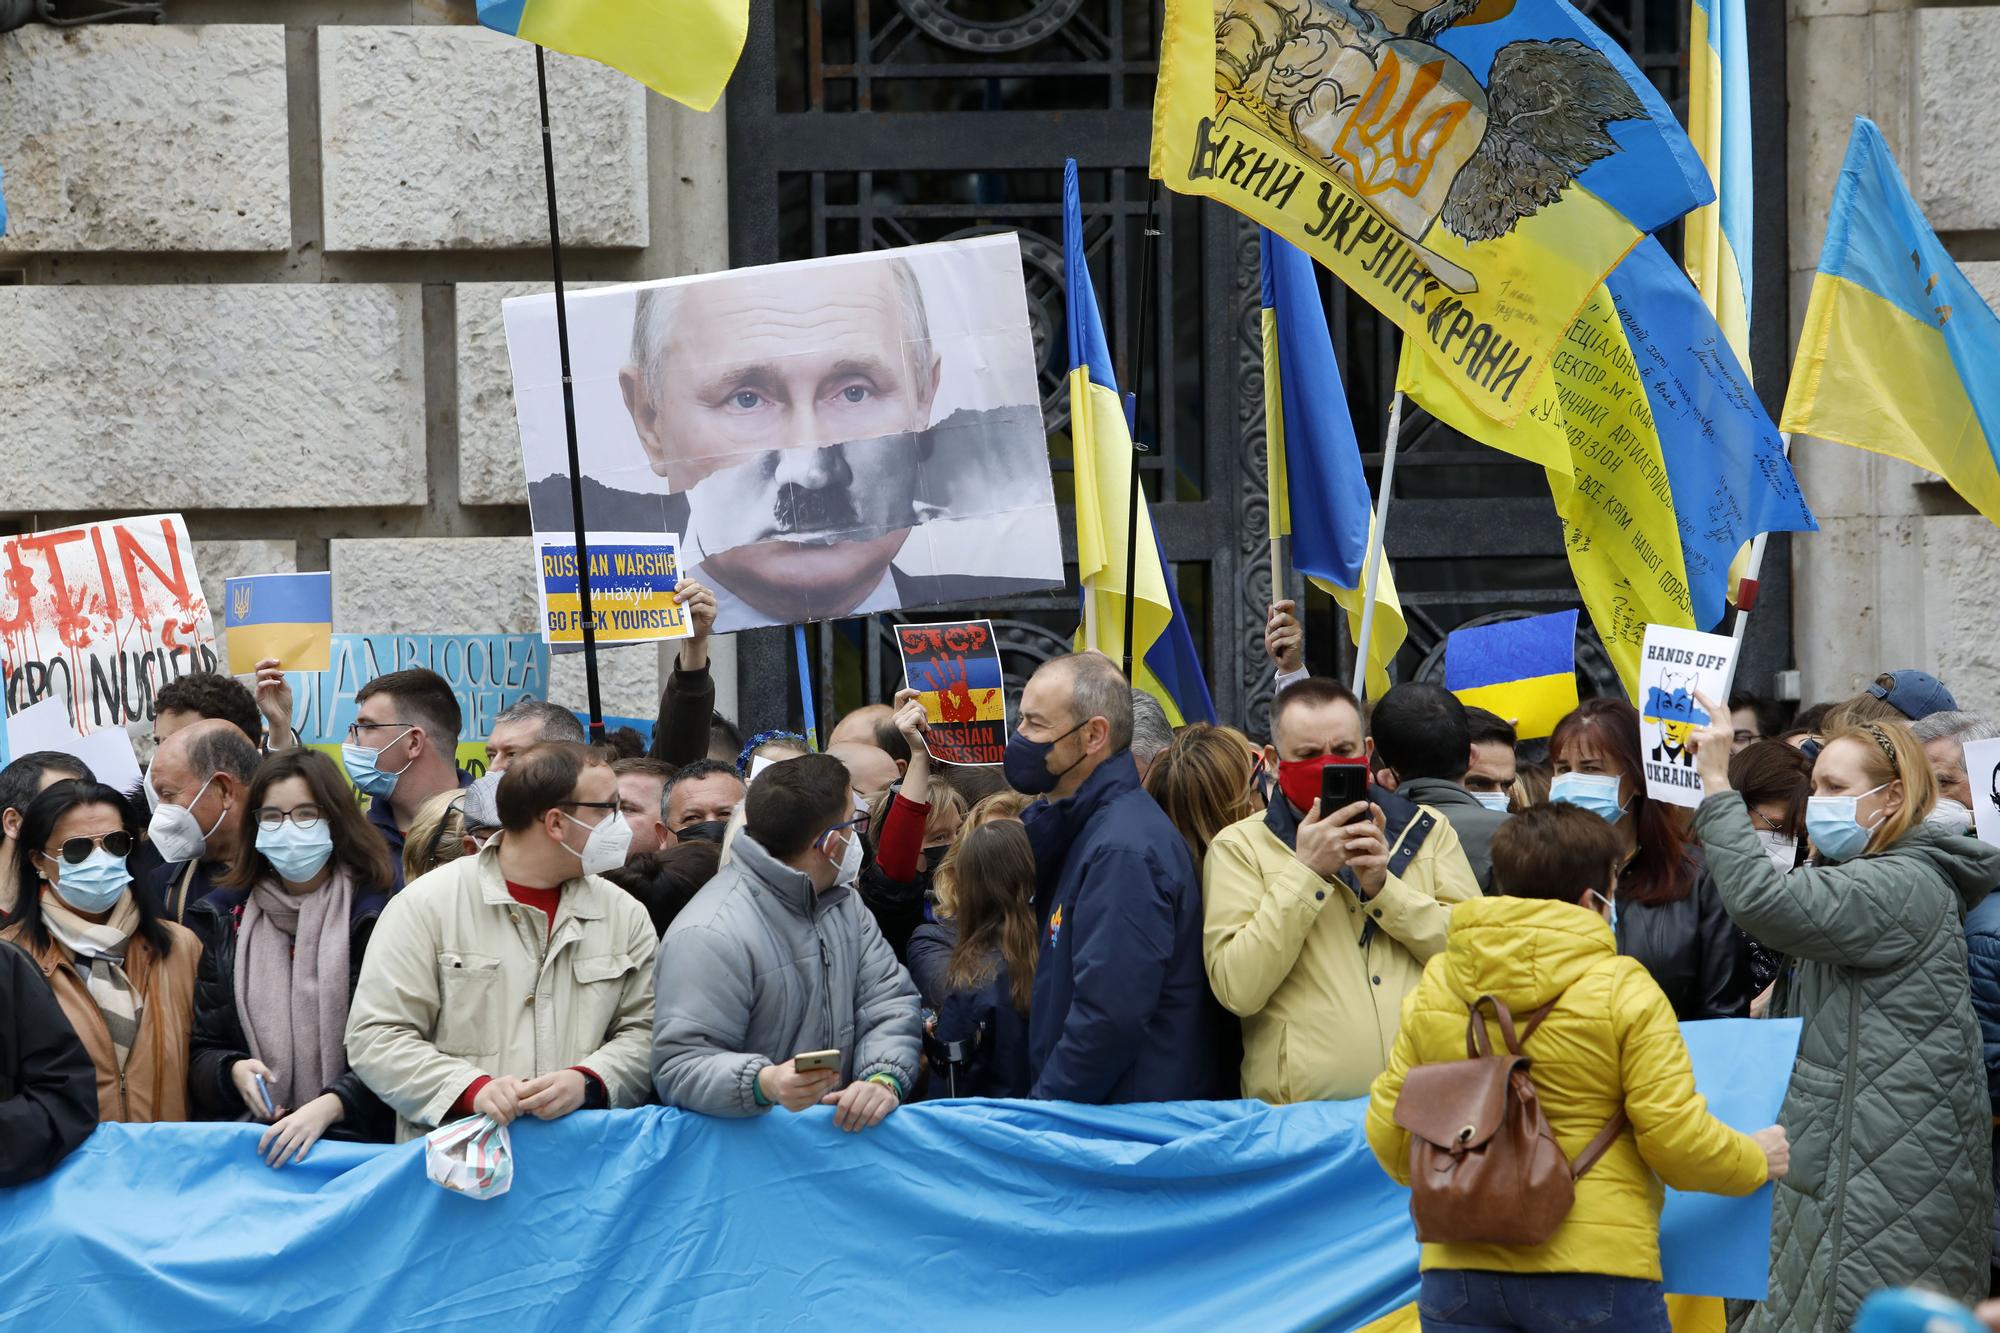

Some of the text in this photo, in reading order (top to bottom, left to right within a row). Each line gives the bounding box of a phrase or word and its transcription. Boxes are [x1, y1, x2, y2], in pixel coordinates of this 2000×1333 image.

[1553, 351, 1607, 385] СЕКТОР
[1555, 381, 1610, 429] ИЧНИЙ
[1565, 423, 1624, 473] ИВІЗІОН
[1578, 474, 1607, 505] ВСЕ,
[1602, 494, 1633, 531] КРІМ
[1631, 529, 1664, 574] НАШОЇ
[543, 552, 677, 577] RUSSAN WARSHIP
[575, 582, 653, 606] іи нахуй
[547, 610, 567, 632] GO
[611, 607, 685, 631] YOURSELF
[1647, 645, 1727, 671] HANDS OFF
[927, 727, 994, 746] RUSSIAN
[1646, 762, 1702, 790] UKRAINE
